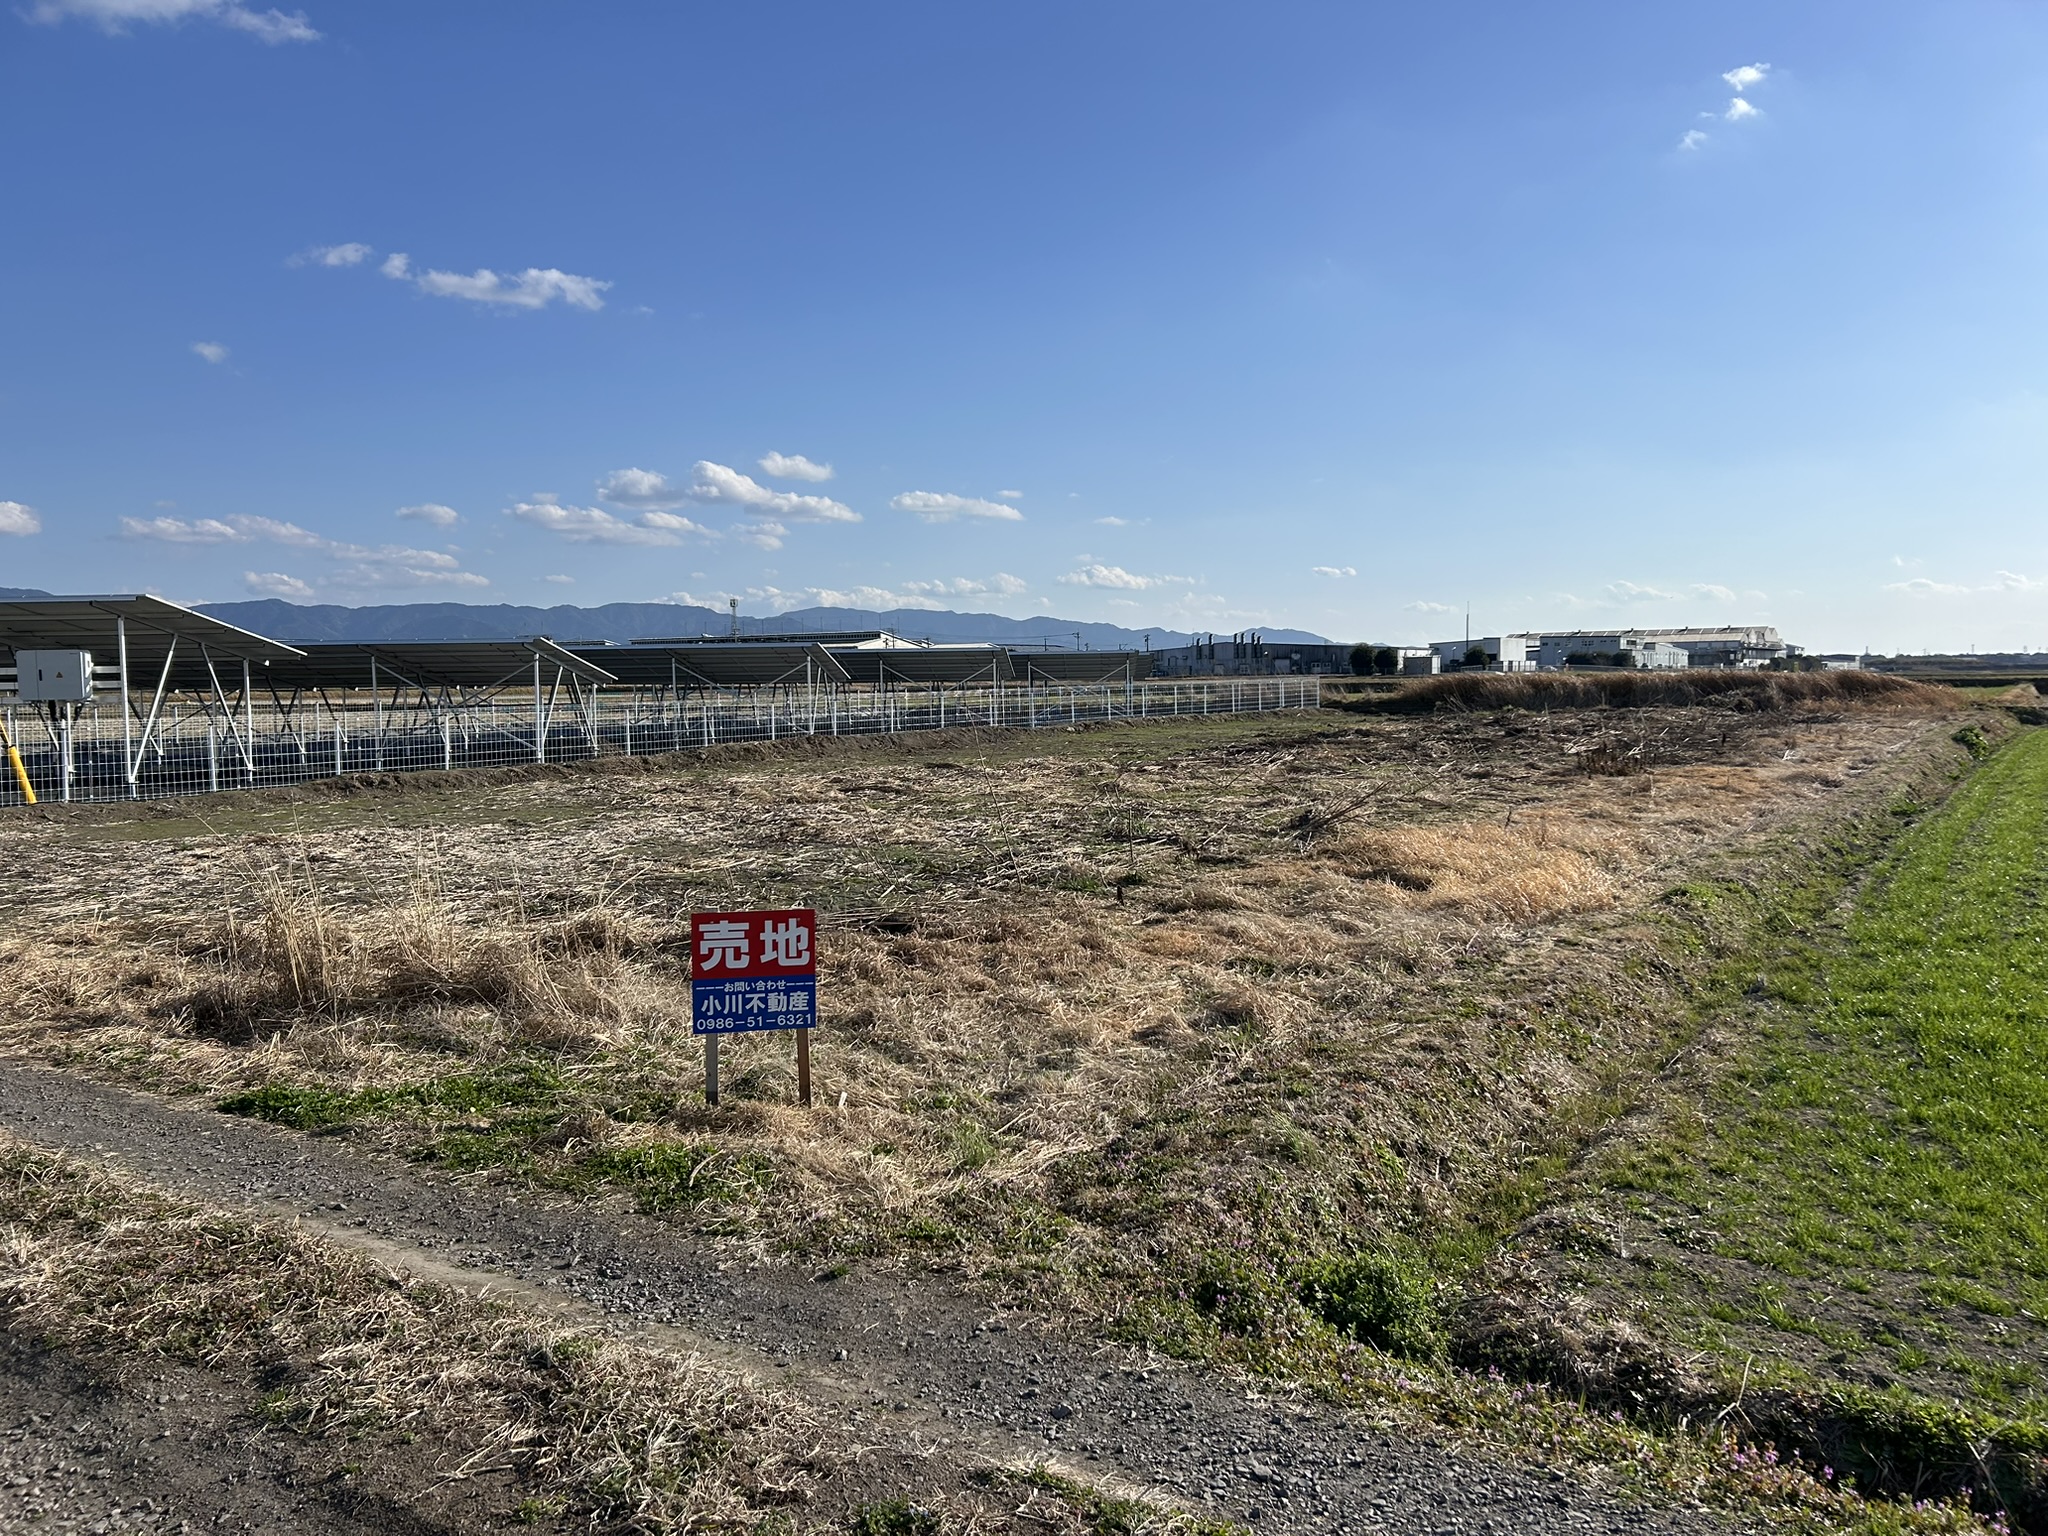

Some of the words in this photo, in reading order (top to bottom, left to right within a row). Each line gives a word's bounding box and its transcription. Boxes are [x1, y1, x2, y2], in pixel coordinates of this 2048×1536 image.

[699, 918, 811, 971] 売地
[724, 980, 787, 992] お問い合わせ
[701, 991, 809, 1016] 小川不動産
[696, 1014, 811, 1030] 0986-51-6321
